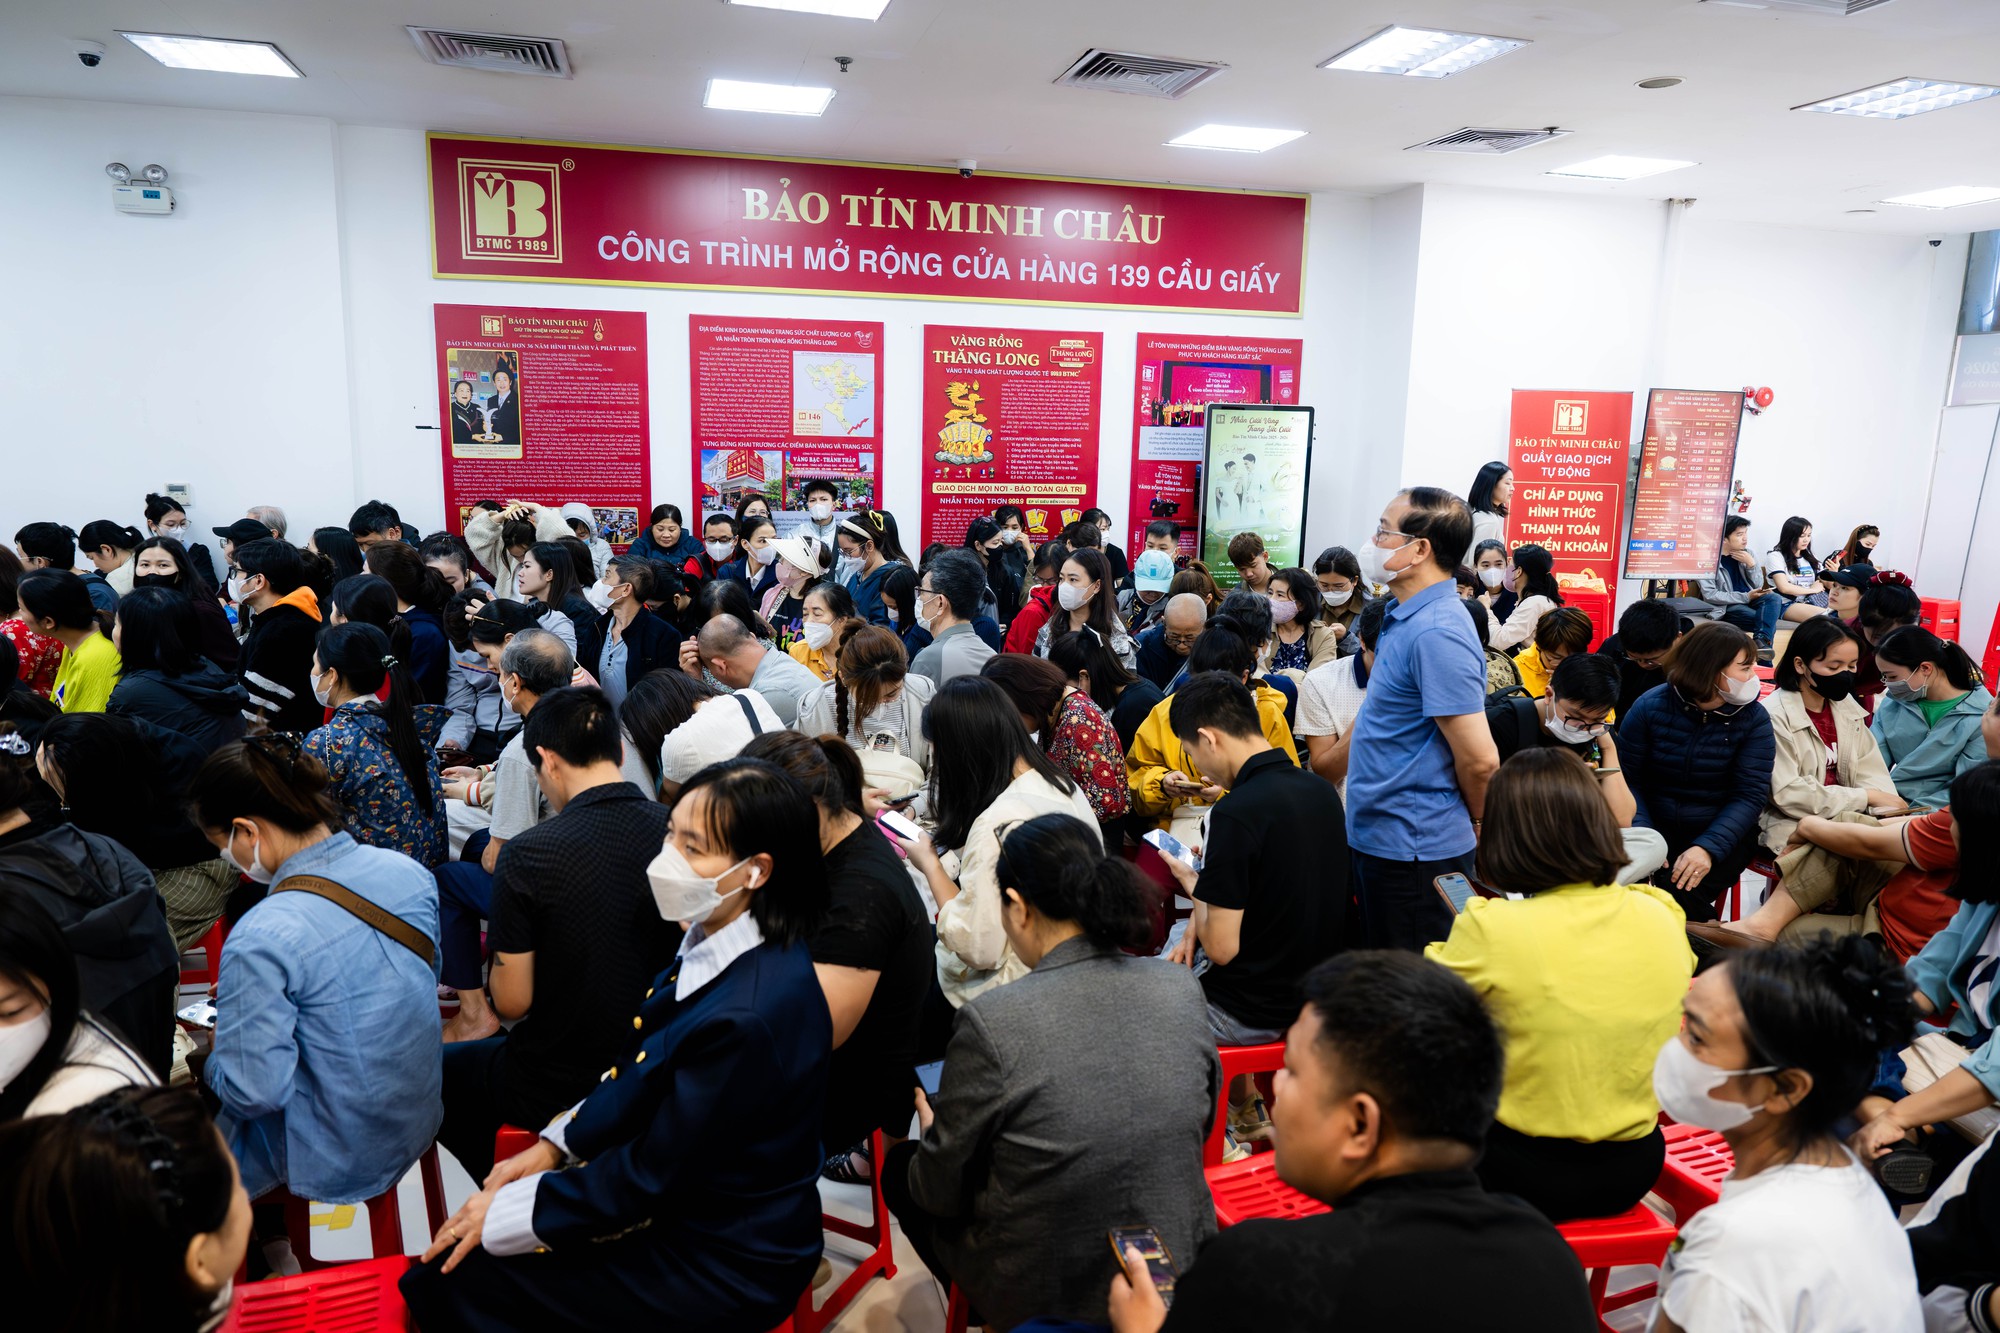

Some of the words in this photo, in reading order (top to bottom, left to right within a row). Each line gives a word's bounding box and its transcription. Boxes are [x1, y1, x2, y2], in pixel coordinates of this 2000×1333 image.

[741, 178, 829, 224] BẢO
[840, 188, 915, 230] TÍN
[926, 200, 1044, 237] MINH
[1054, 204, 1165, 245] CHÂU
[476, 237, 512, 250] BTMC
[517, 240, 547, 251] 1989
[598, 231, 690, 264] CÔNG
[700, 236, 793, 269] TRÌNH
[804, 239, 850, 272] MỞ
[859, 244, 942, 281] RỘNG
[952, 247, 1010, 280] CỬA
[1020, 253, 1097, 286] HÀNG
[1107, 264, 1149, 288] 139
[1158, 257, 1212, 291] CẦU
[1220, 260, 1281, 294] GIẤY
[508, 316, 525, 325] BẢO
[526, 317, 540, 325] TÍN
[566, 318, 588, 327] CHÂU
[446, 340, 460, 349] BẢO
[461, 340, 472, 349] TÍN
[951, 334, 985, 347] VÀNG
[989, 334, 1023, 348] RỒNG
[933, 348, 991, 365] THĂNG
[996, 353, 1039, 366] LONG
[1515, 436, 1537, 447] BẢO
[1539, 436, 1558, 447] TÍN
[1560, 439, 1589, 448] MINH
[1591, 438, 1621, 449] CHÂU
[1522, 450, 1552, 464] QUẦY
[1555, 453, 1582, 464] GIAO
[1585, 454, 1611, 467] DỊCH
[1541, 467, 1556, 478] TỰ
[1558, 465, 1590, 479] ĐỘNG
[940, 496, 962, 504] NHẪN
[1523, 488, 1546, 500] CHỈ
[1548, 488, 1565, 500] ÁP
[1568, 490, 1603, 503] DỤNG
[1528, 504, 1559, 517] HÌNH
[1562, 504, 1596, 518] THỨC
[1521, 523, 1563, 538] THANH
[1566, 522, 1600, 536] TOÁN
[1564, 538, 1608, 553] KHOẢN
